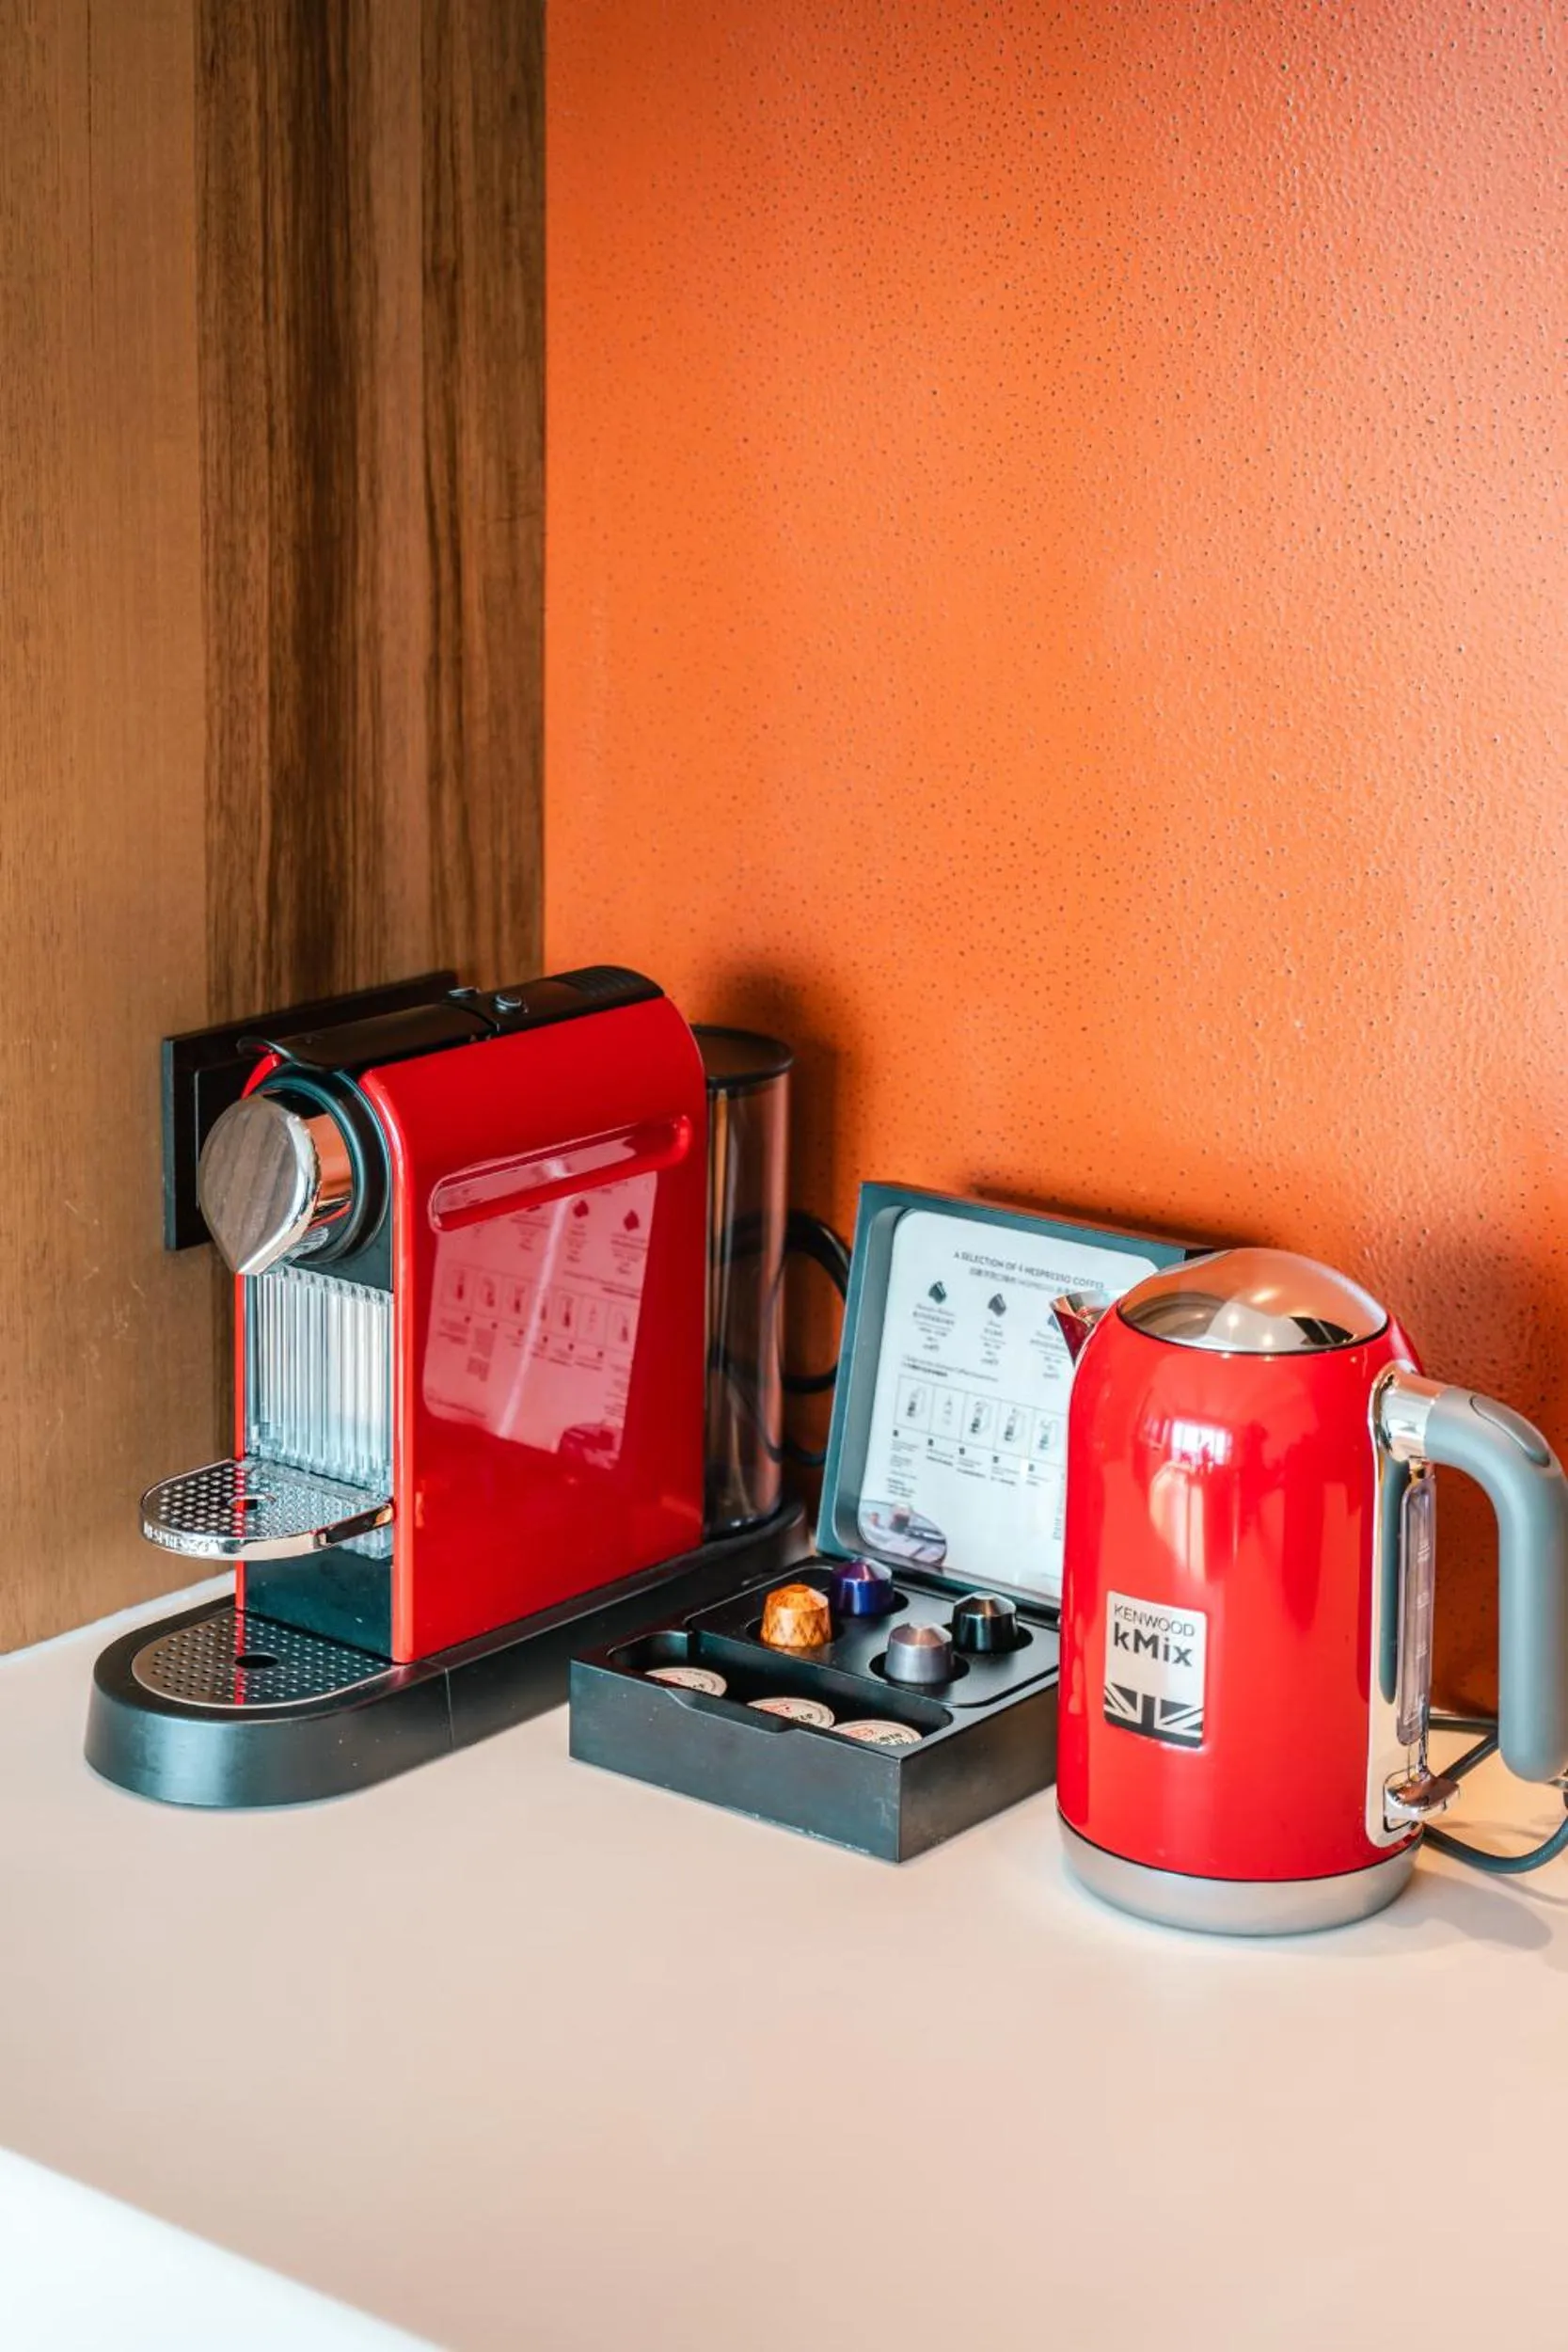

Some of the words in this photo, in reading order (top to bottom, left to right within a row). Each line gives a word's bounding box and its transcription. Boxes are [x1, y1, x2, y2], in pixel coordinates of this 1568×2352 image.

[961, 1252, 1004, 1268] SELECTION
[1114, 1603, 1195, 1637] KENWOOD
[1114, 1621, 1193, 1667] kMix
